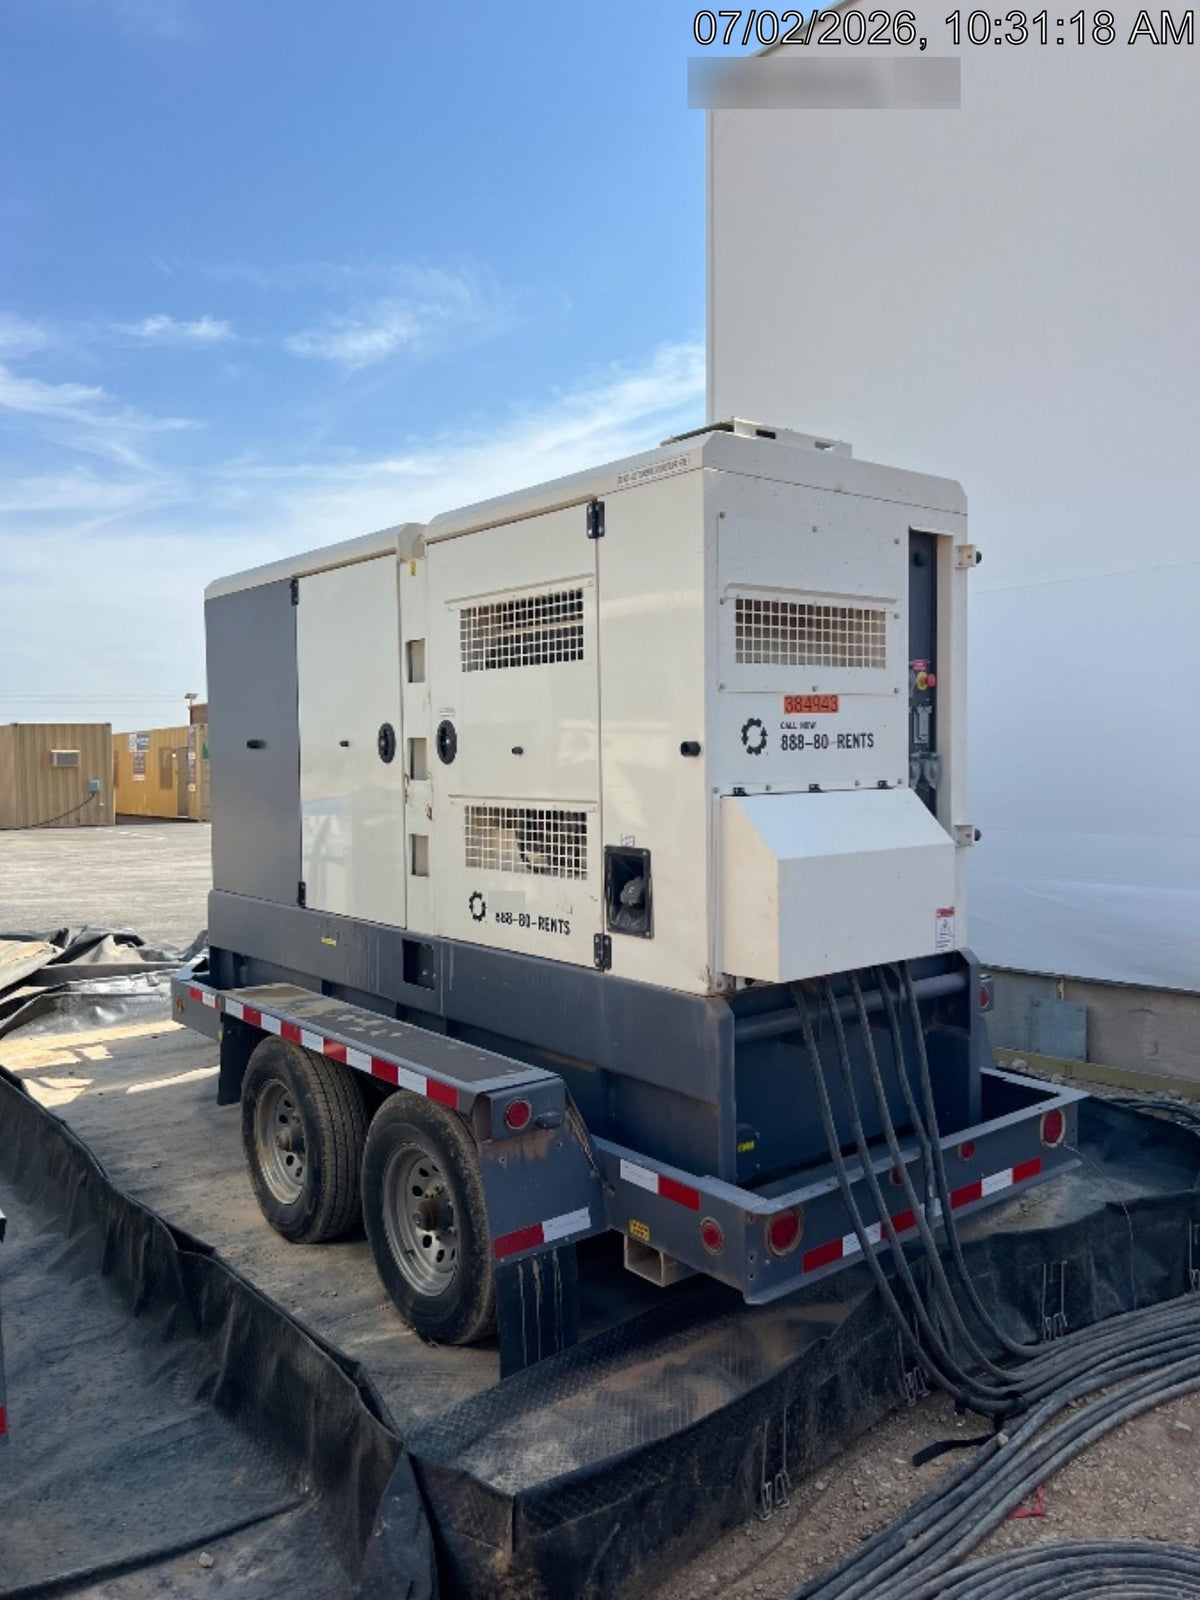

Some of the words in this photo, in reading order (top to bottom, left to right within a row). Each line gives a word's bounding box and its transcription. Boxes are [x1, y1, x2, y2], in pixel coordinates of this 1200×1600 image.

[784, 695, 838, 713] 384943
[780, 721, 797, 730] CALL
[800, 721, 817, 730] NOW
